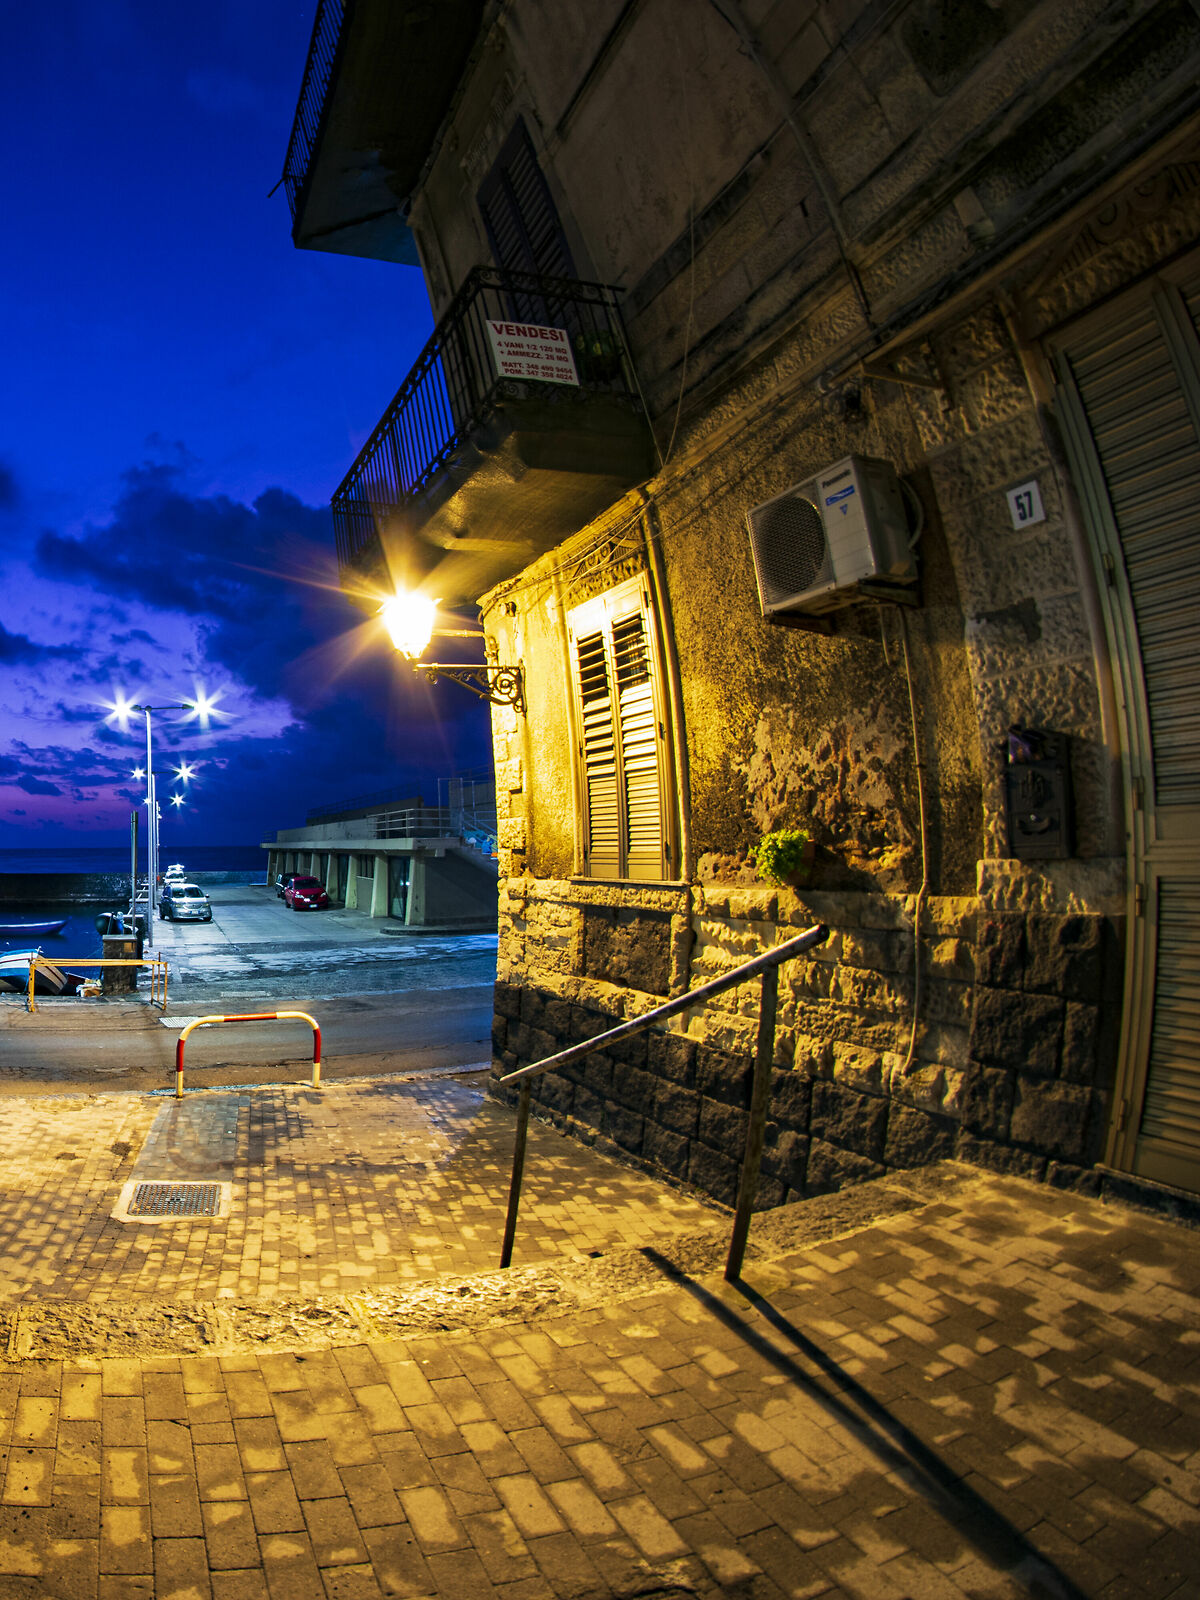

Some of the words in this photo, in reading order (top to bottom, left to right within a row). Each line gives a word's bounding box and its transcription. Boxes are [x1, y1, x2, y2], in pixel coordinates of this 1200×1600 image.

[492, 323, 565, 342] VENDESI
[539, 345, 553, 353] 120
[1015, 490, 1033, 521] 57
